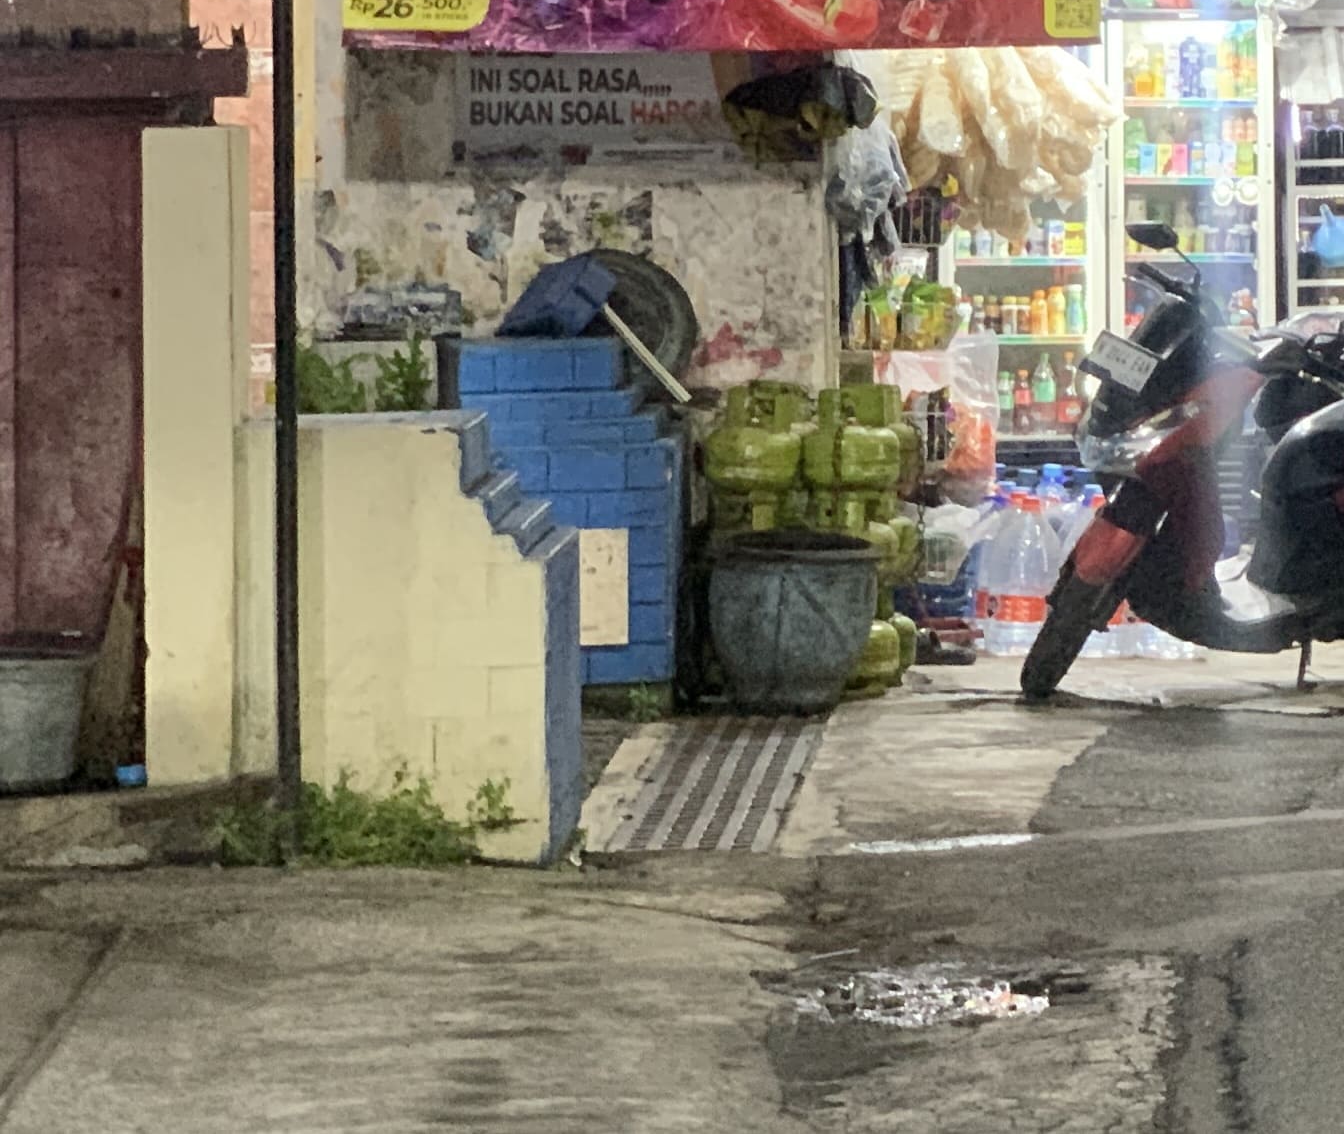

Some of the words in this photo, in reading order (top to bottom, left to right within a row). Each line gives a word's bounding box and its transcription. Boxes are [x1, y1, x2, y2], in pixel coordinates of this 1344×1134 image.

[470, 68, 502, 93] INI
[508, 68, 572, 94] SOAL
[470, 100, 554, 126] BUKAN
[561, 100, 625, 126] SOAL
